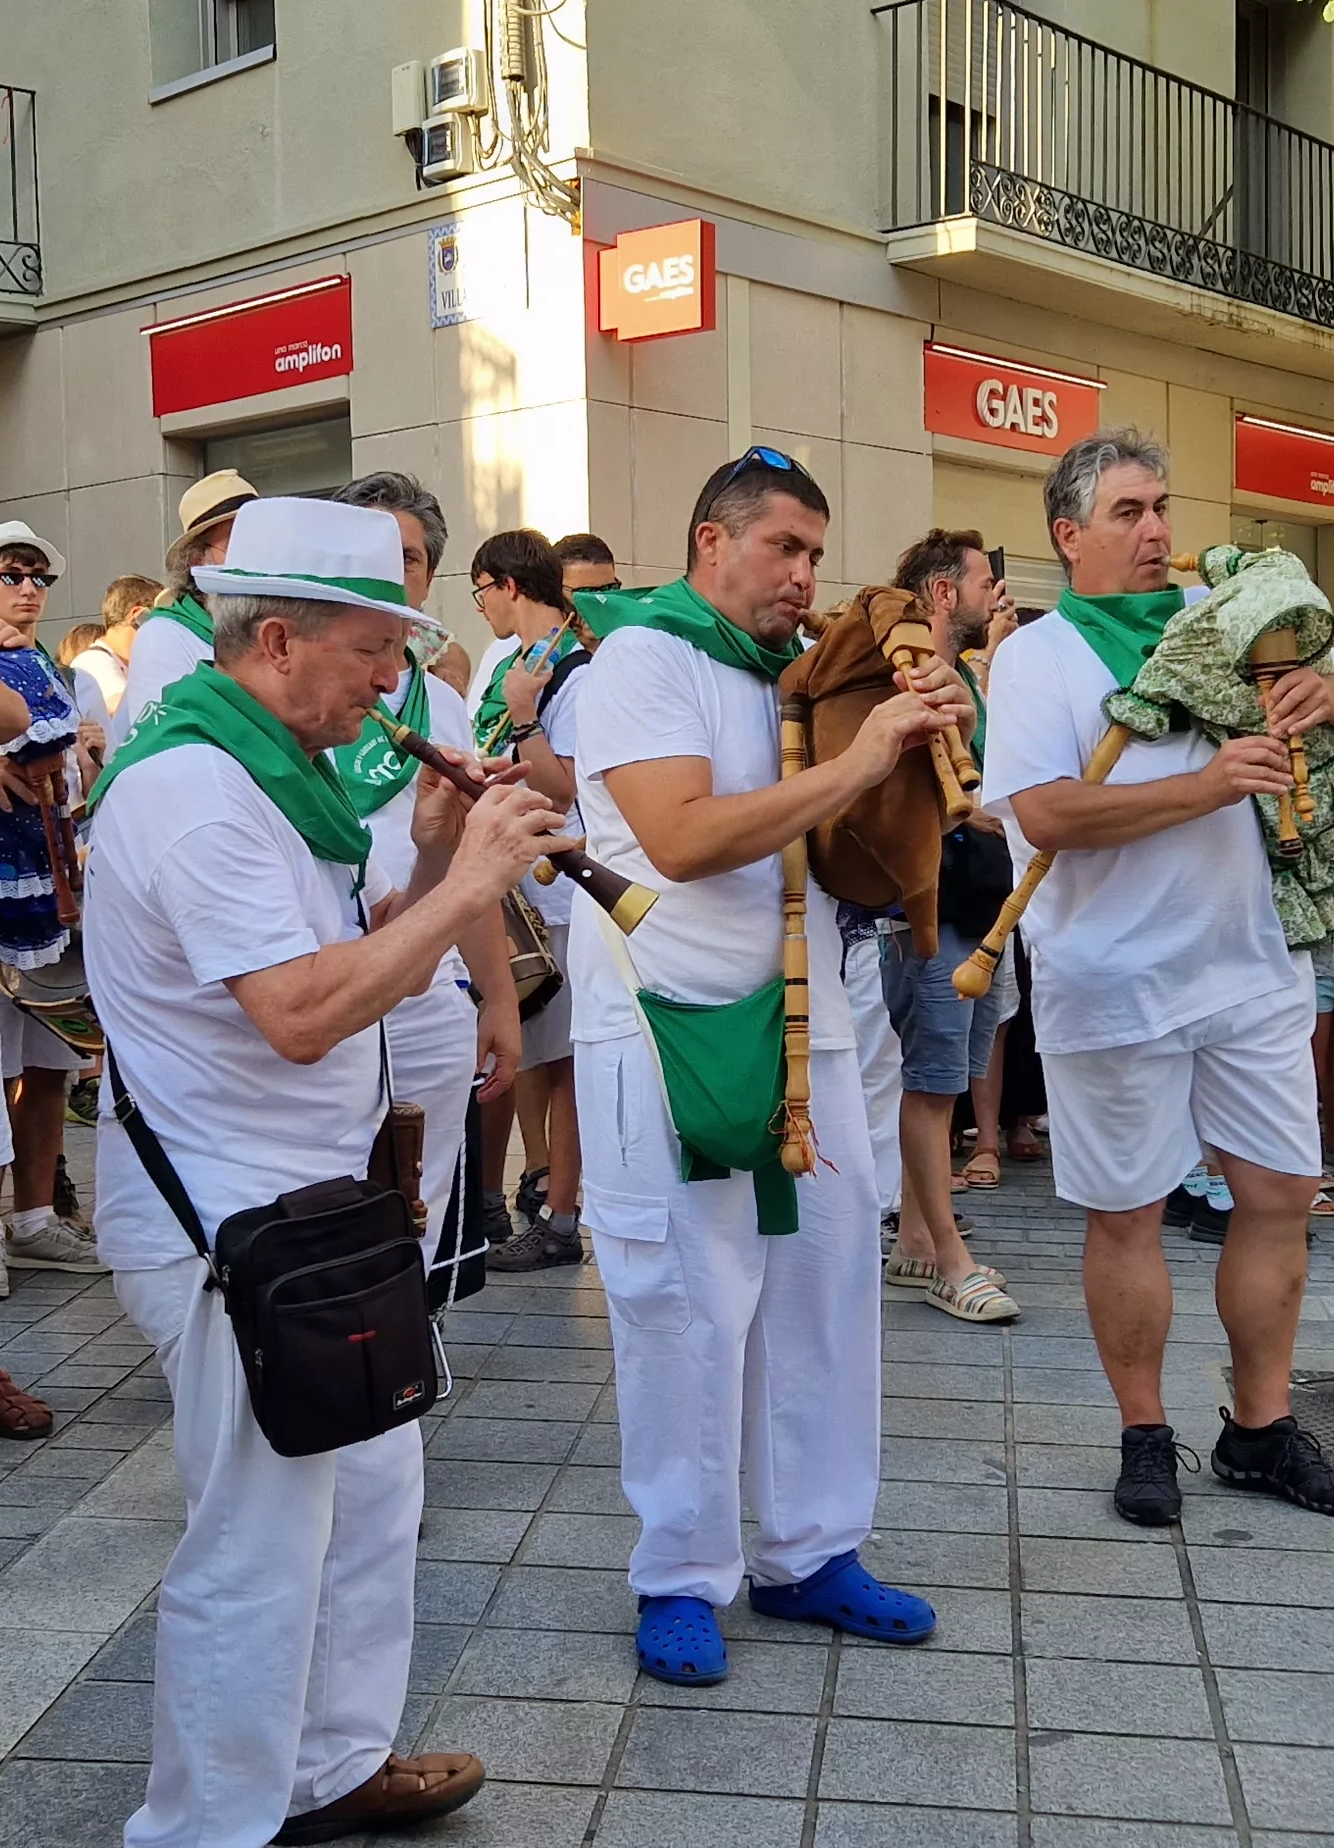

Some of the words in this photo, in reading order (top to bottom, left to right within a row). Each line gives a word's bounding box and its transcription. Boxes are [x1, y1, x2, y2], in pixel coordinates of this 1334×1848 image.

[624, 254, 695, 293] GAES
[441, 288, 466, 309] VILL
[275, 342, 341, 373] amplifon
[976, 379, 1059, 439] GAES
